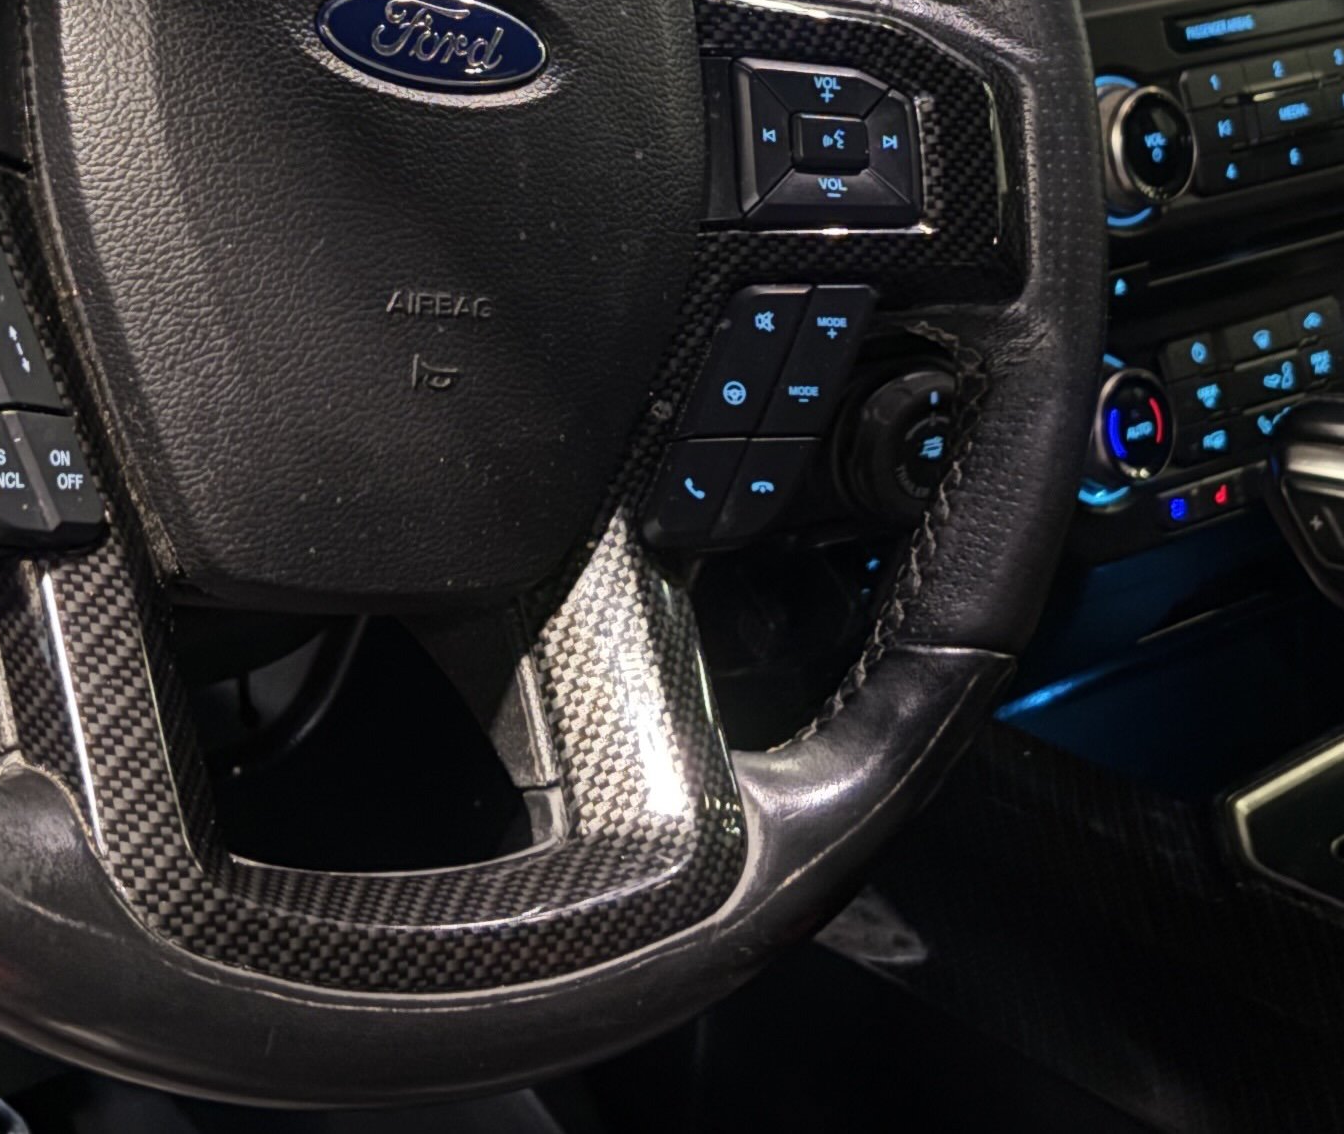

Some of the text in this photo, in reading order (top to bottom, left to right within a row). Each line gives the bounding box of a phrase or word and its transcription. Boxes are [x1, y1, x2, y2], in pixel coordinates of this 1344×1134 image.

[1272, 60, 1285, 78] 2
[814, 76, 841, 90] VOL
[1209, 74, 1221, 91] 1
[1226, 163, 1238, 180] 4
[818, 177, 847, 192] VOL
[386, 289, 491, 317] AIRBAG
[817, 317, 847, 328] MODE
[789, 385, 819, 397] MODE
[50, 449, 70, 466] ON
[57, 473, 84, 489] OFF
